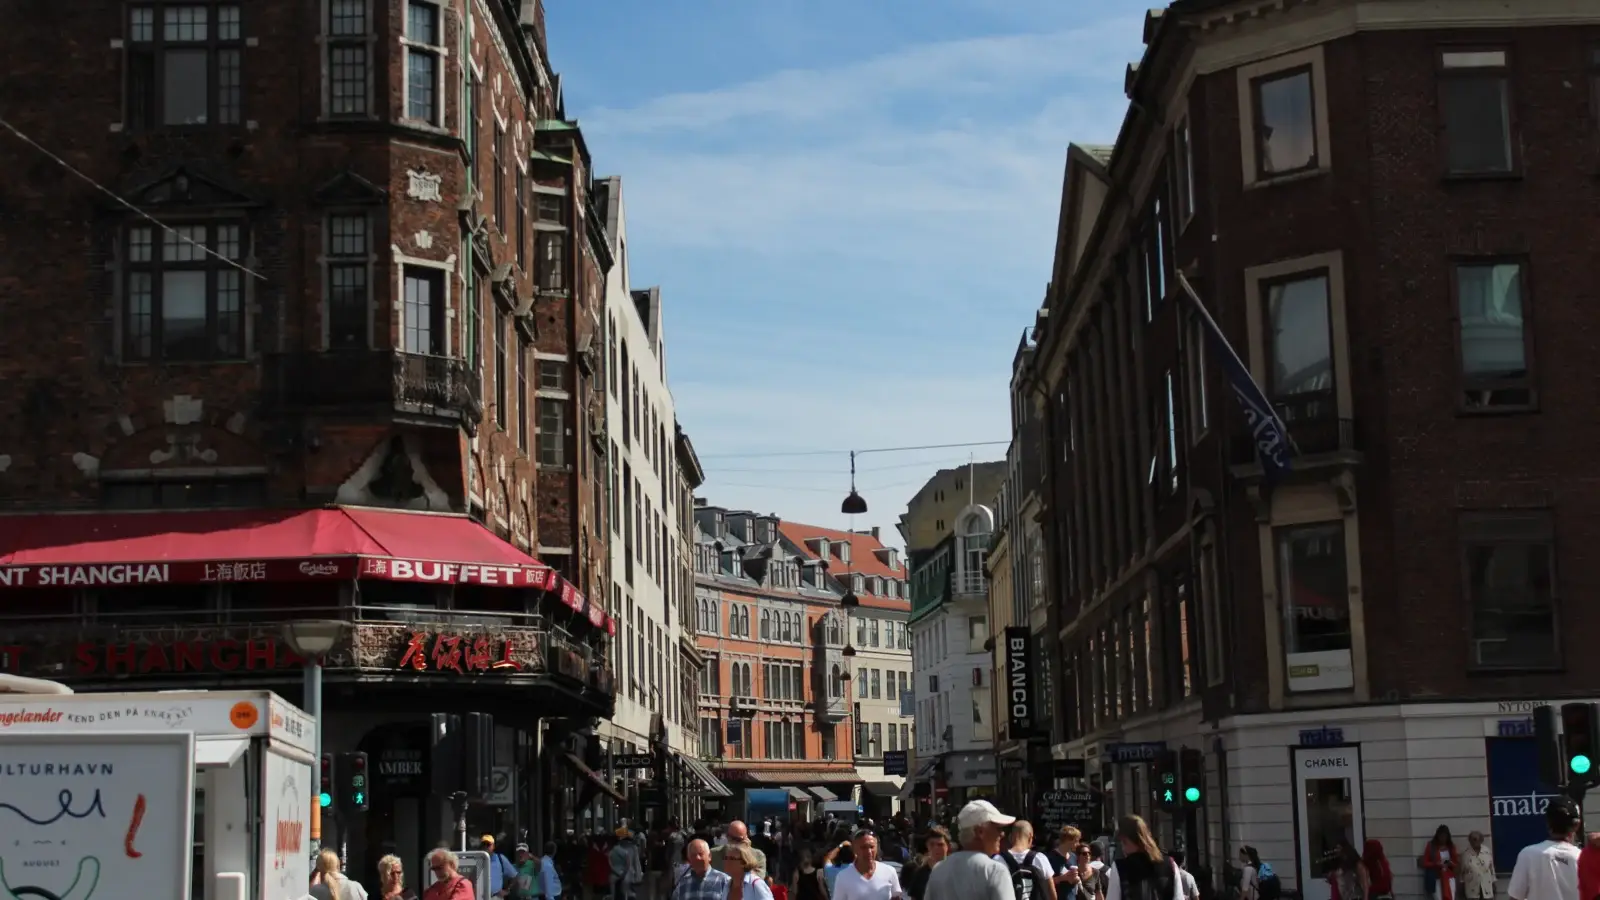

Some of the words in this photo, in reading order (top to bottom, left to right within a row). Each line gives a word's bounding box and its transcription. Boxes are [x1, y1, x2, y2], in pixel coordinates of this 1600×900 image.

[38, 563, 170, 586] SHANGHAI
[201, 562, 266, 582] 上海飯店
[299, 561, 339, 576] Carlsberg
[363, 559, 387, 575] 上海
[391, 559, 522, 585] BUFFET
[67, 713, 95, 725] KEND
[99, 709, 122, 722] DEN
[125, 706, 140, 718] PÅ
[378, 760, 423, 775] AMBER
[615, 754, 651, 766] ALDO
[1304, 757, 1349, 769] CHANEL
[1492, 790, 1550, 817] mata
